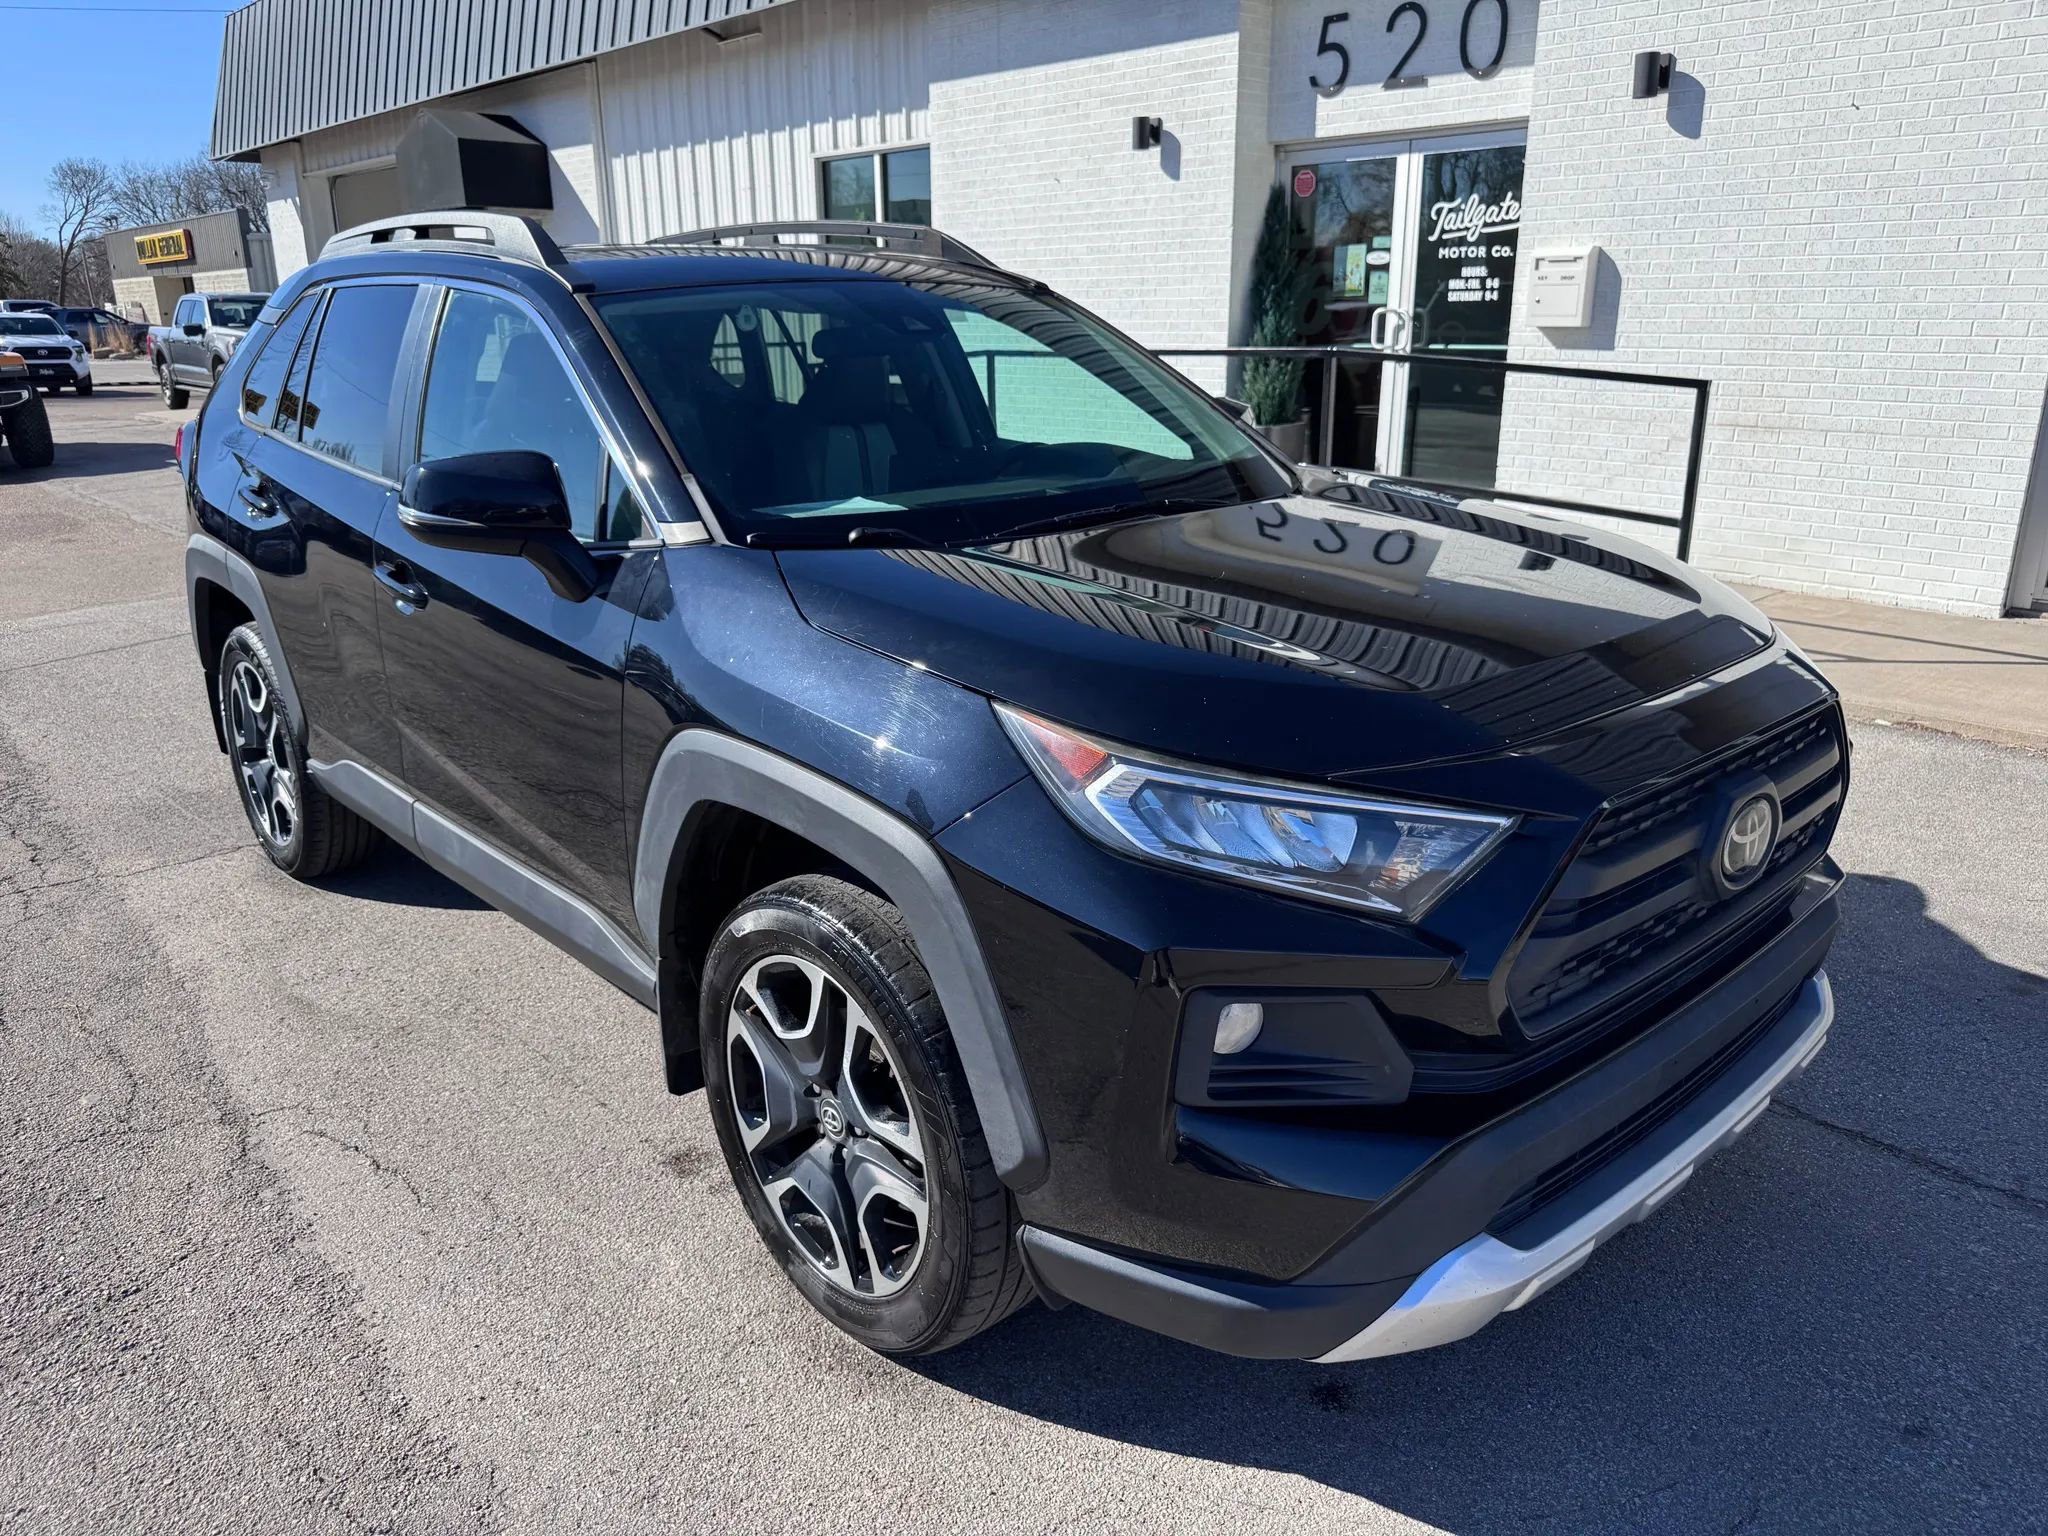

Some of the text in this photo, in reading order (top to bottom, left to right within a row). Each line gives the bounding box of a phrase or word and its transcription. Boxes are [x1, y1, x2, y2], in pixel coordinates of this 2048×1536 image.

[1309, 0, 1509, 98] 520
[1428, 191, 1521, 242] Tailgate
[1438, 245, 1514, 259] MOTOR CO.
